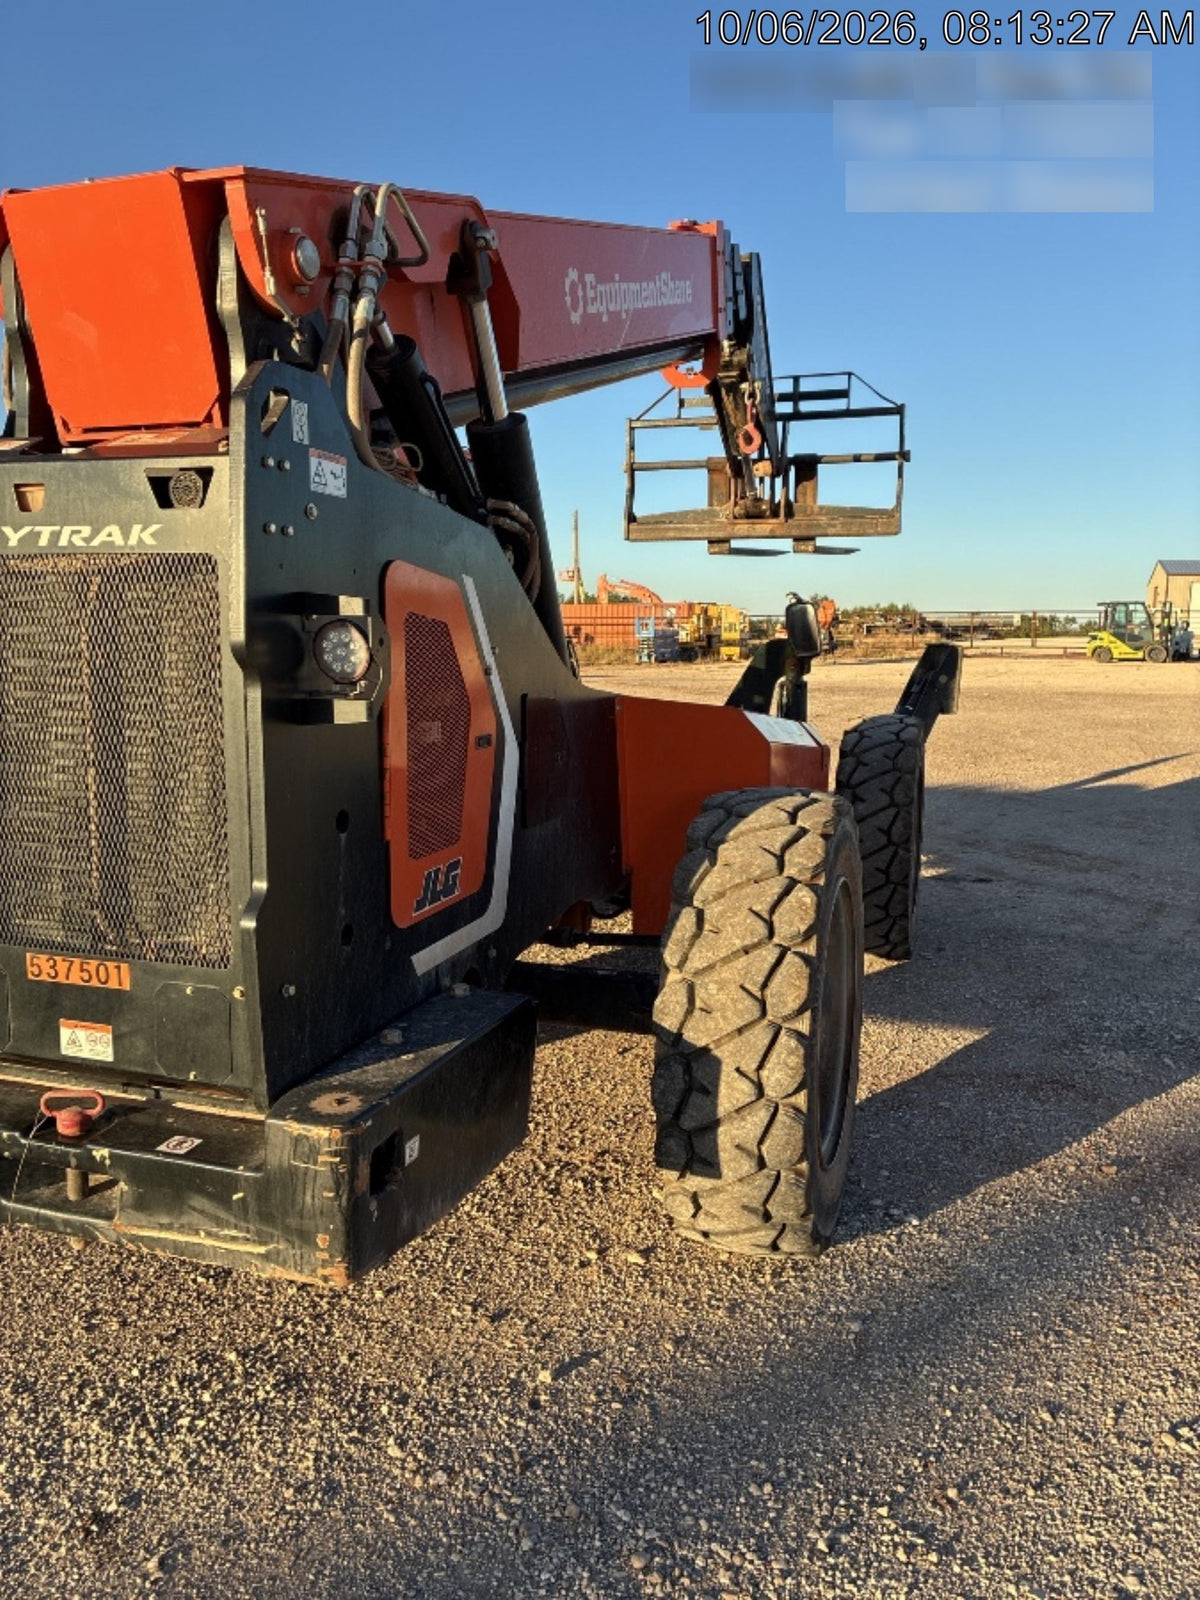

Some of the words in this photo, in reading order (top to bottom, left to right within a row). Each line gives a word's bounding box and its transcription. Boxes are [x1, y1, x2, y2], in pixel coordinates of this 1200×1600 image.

[584, 272, 693, 322] EquipmentShare
[412, 857, 463, 917] JLG
[29, 956, 124, 987] 537501
